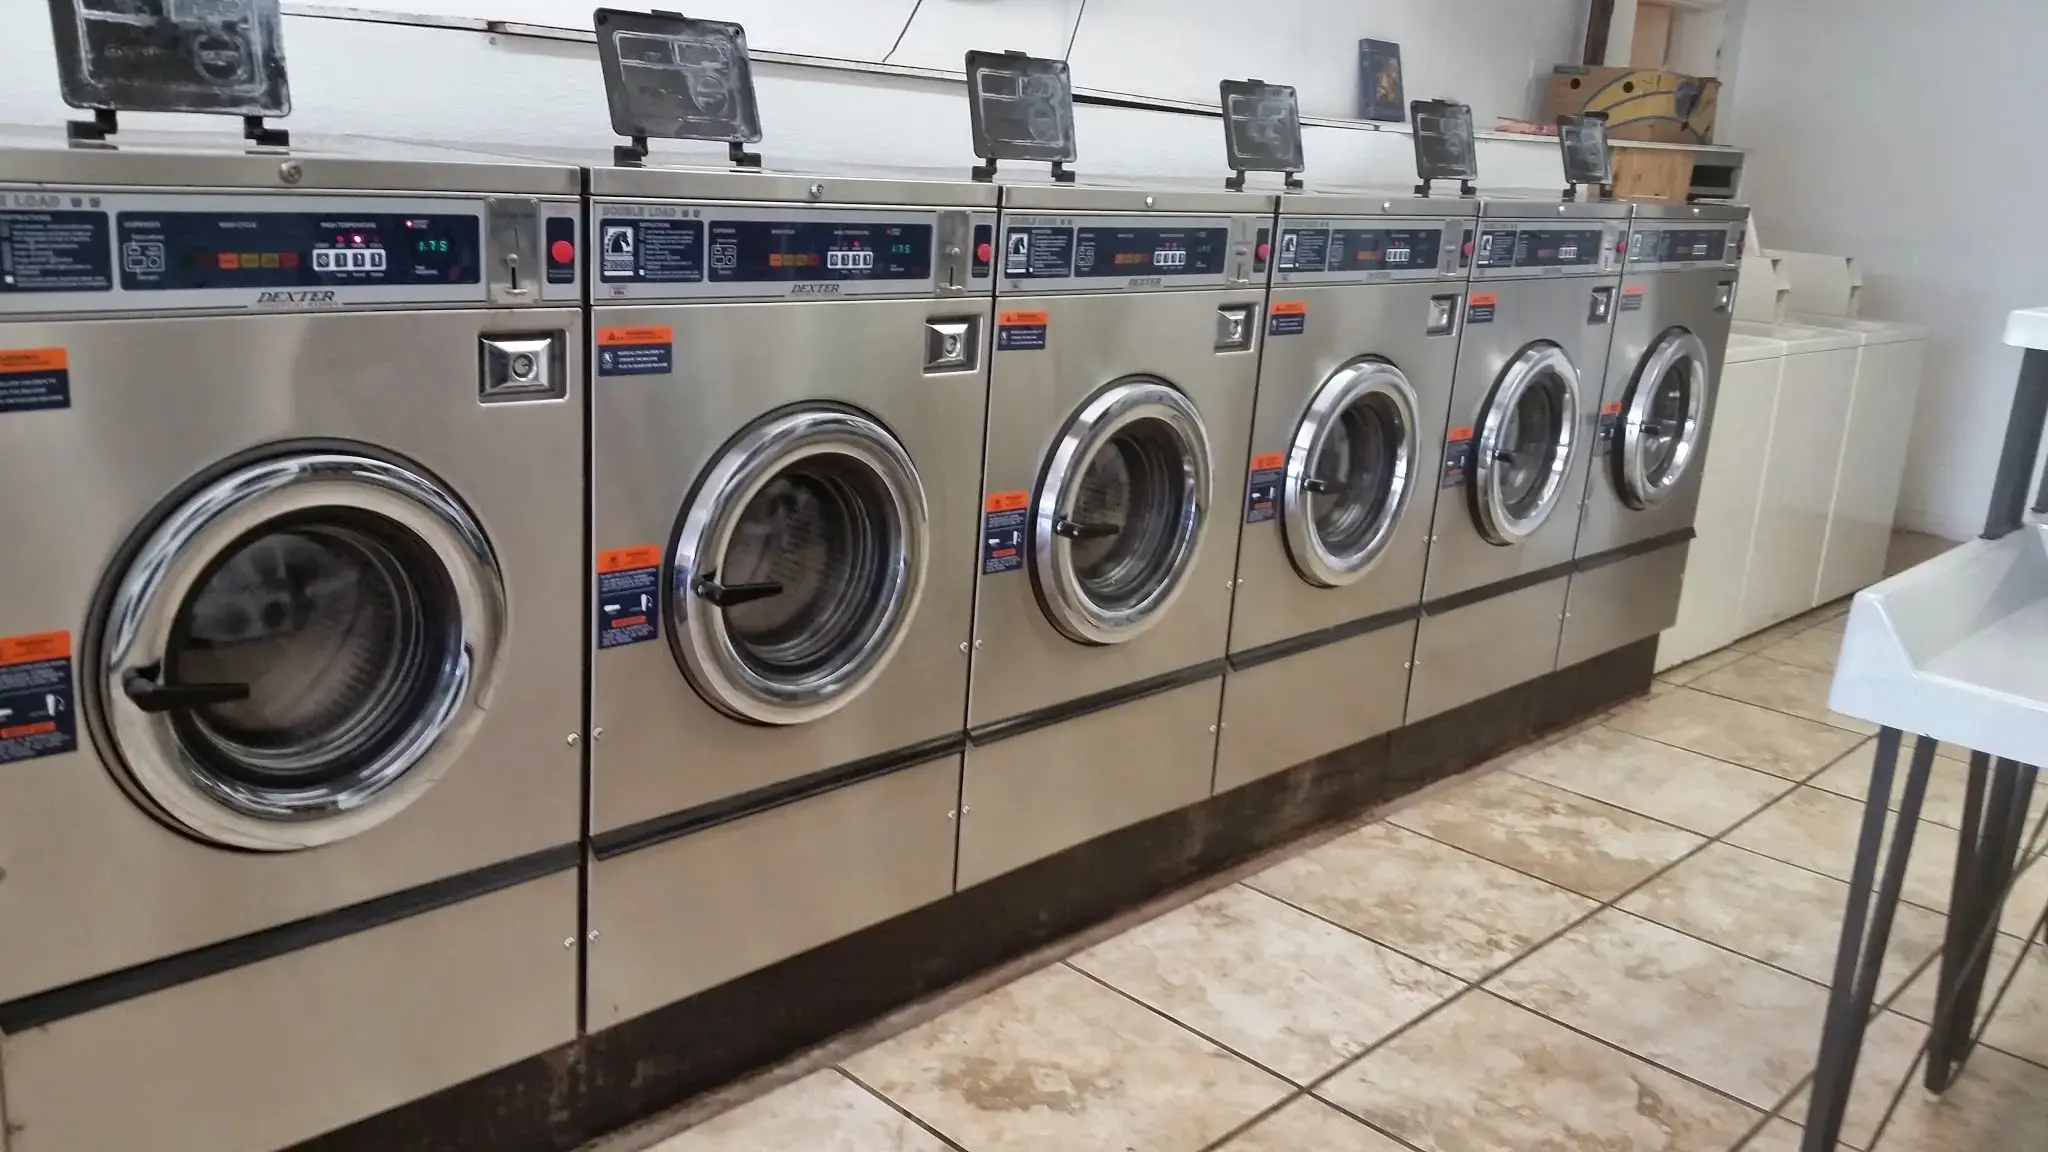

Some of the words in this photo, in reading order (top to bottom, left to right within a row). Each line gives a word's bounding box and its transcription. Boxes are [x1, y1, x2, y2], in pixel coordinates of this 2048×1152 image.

[14, 194, 60, 208] LOAD
[791, 283, 840, 293] DEXTER
[256, 291, 335, 303] DEXTER
